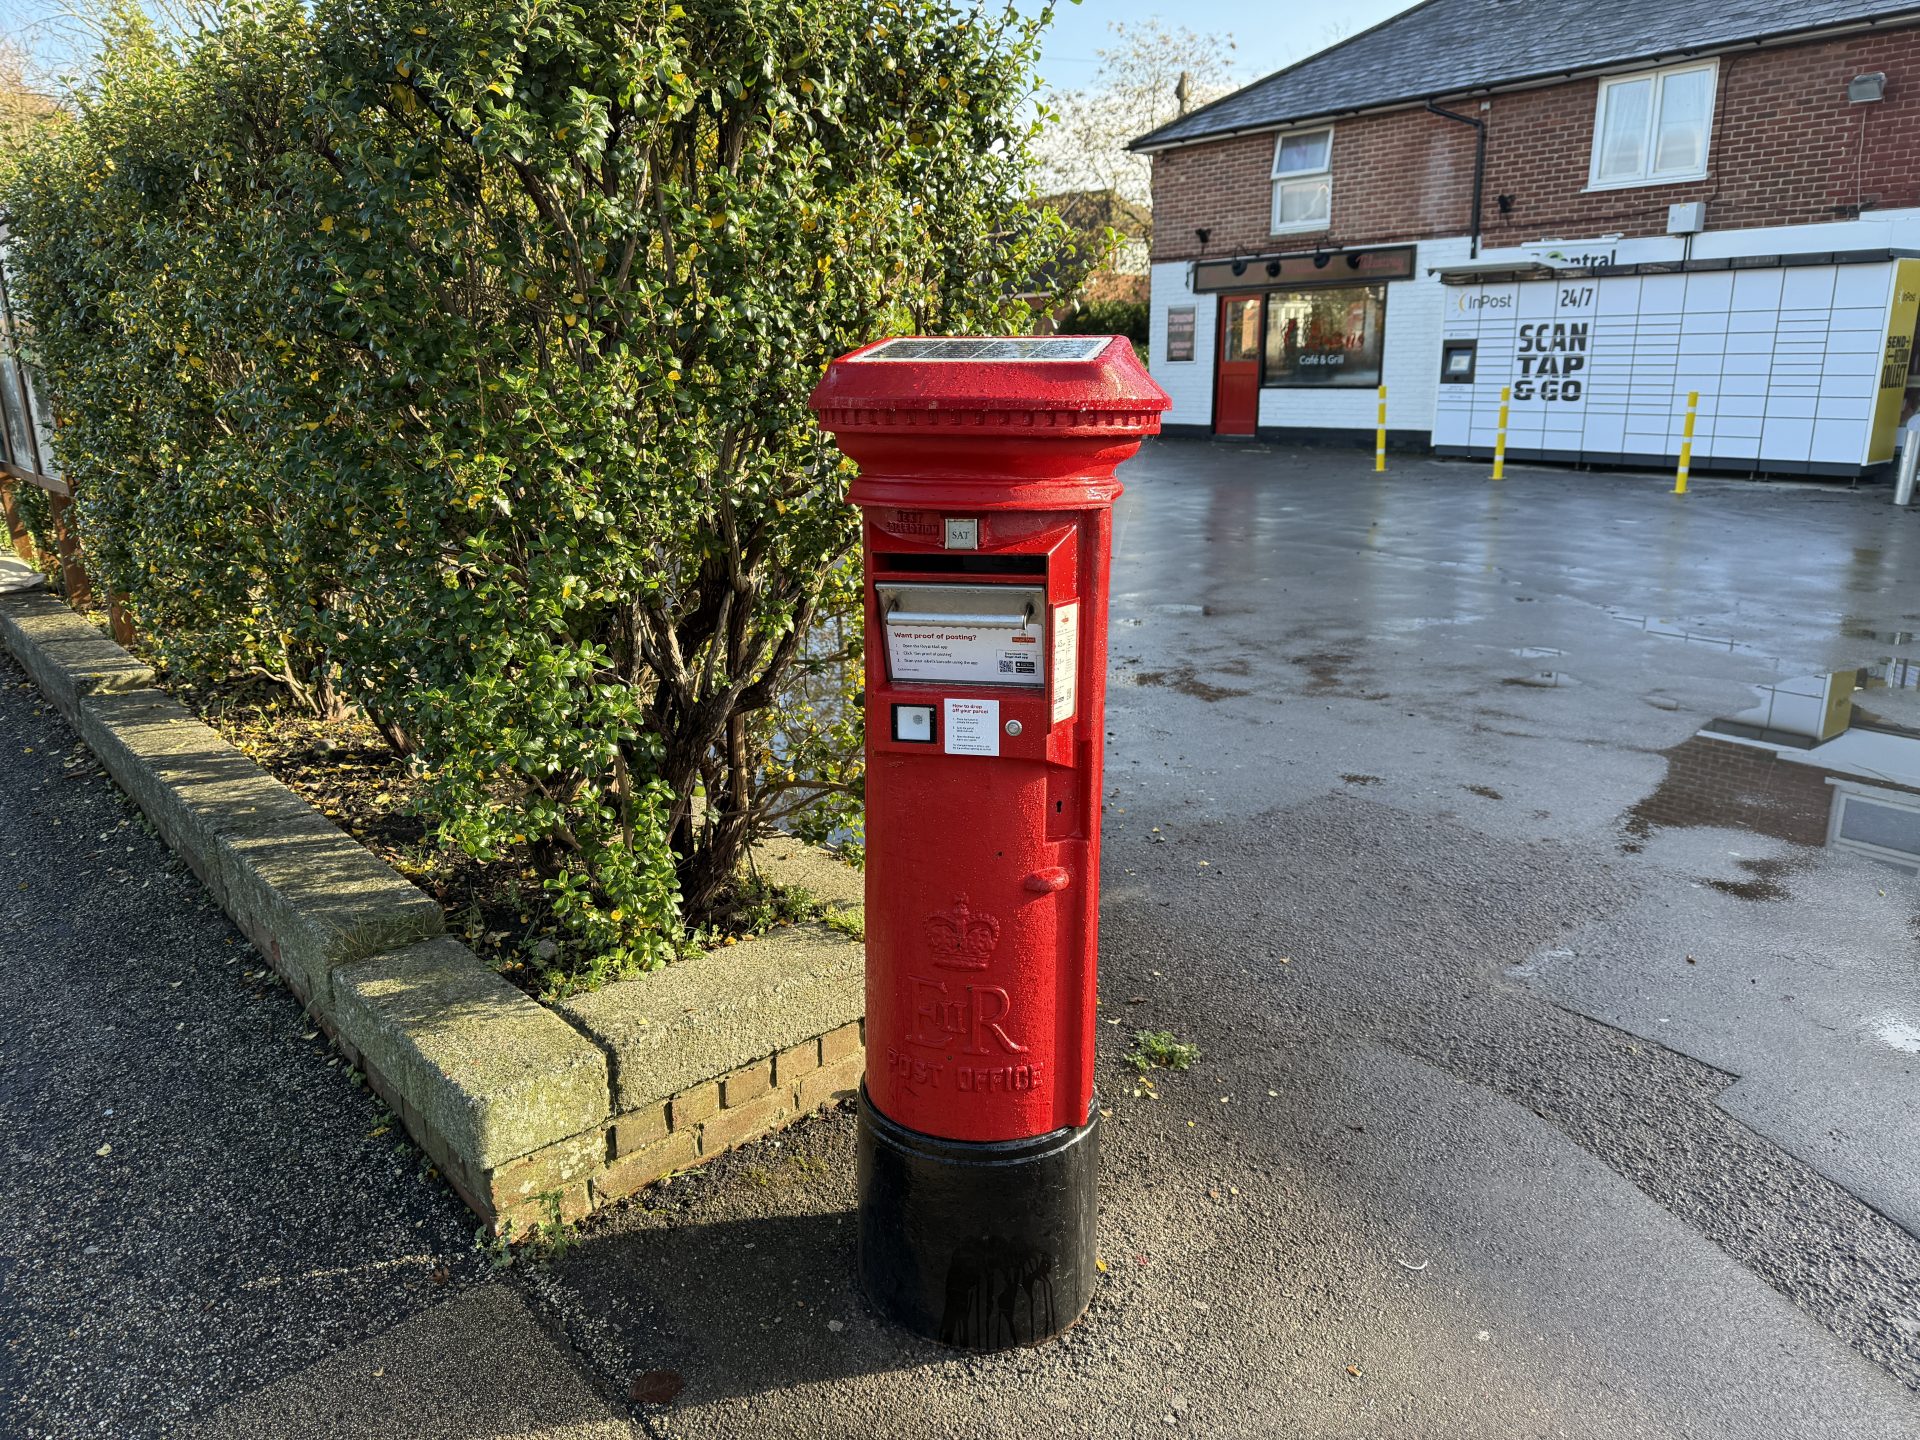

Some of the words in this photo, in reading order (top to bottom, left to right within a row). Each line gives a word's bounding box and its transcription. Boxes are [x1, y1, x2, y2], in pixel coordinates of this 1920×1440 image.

[1469, 293, 1512, 309] InPost
[1561, 287, 1593, 307] 24/7
[1519, 322, 1588, 352] SCAN
[1887, 336, 1907, 348] SEND
[1299, 354, 1319, 365] Café
[1320, 355, 1326, 364] &
[1327, 354, 1345, 364] Grill
[1517, 354, 1584, 378] TAP
[1514, 380, 1535, 400] &
[1541, 380, 1582, 401] GO
[952, 531, 970, 540] SAT
[888, 1047, 944, 1088] POST
[955, 1062, 1045, 1093] OFFICE
